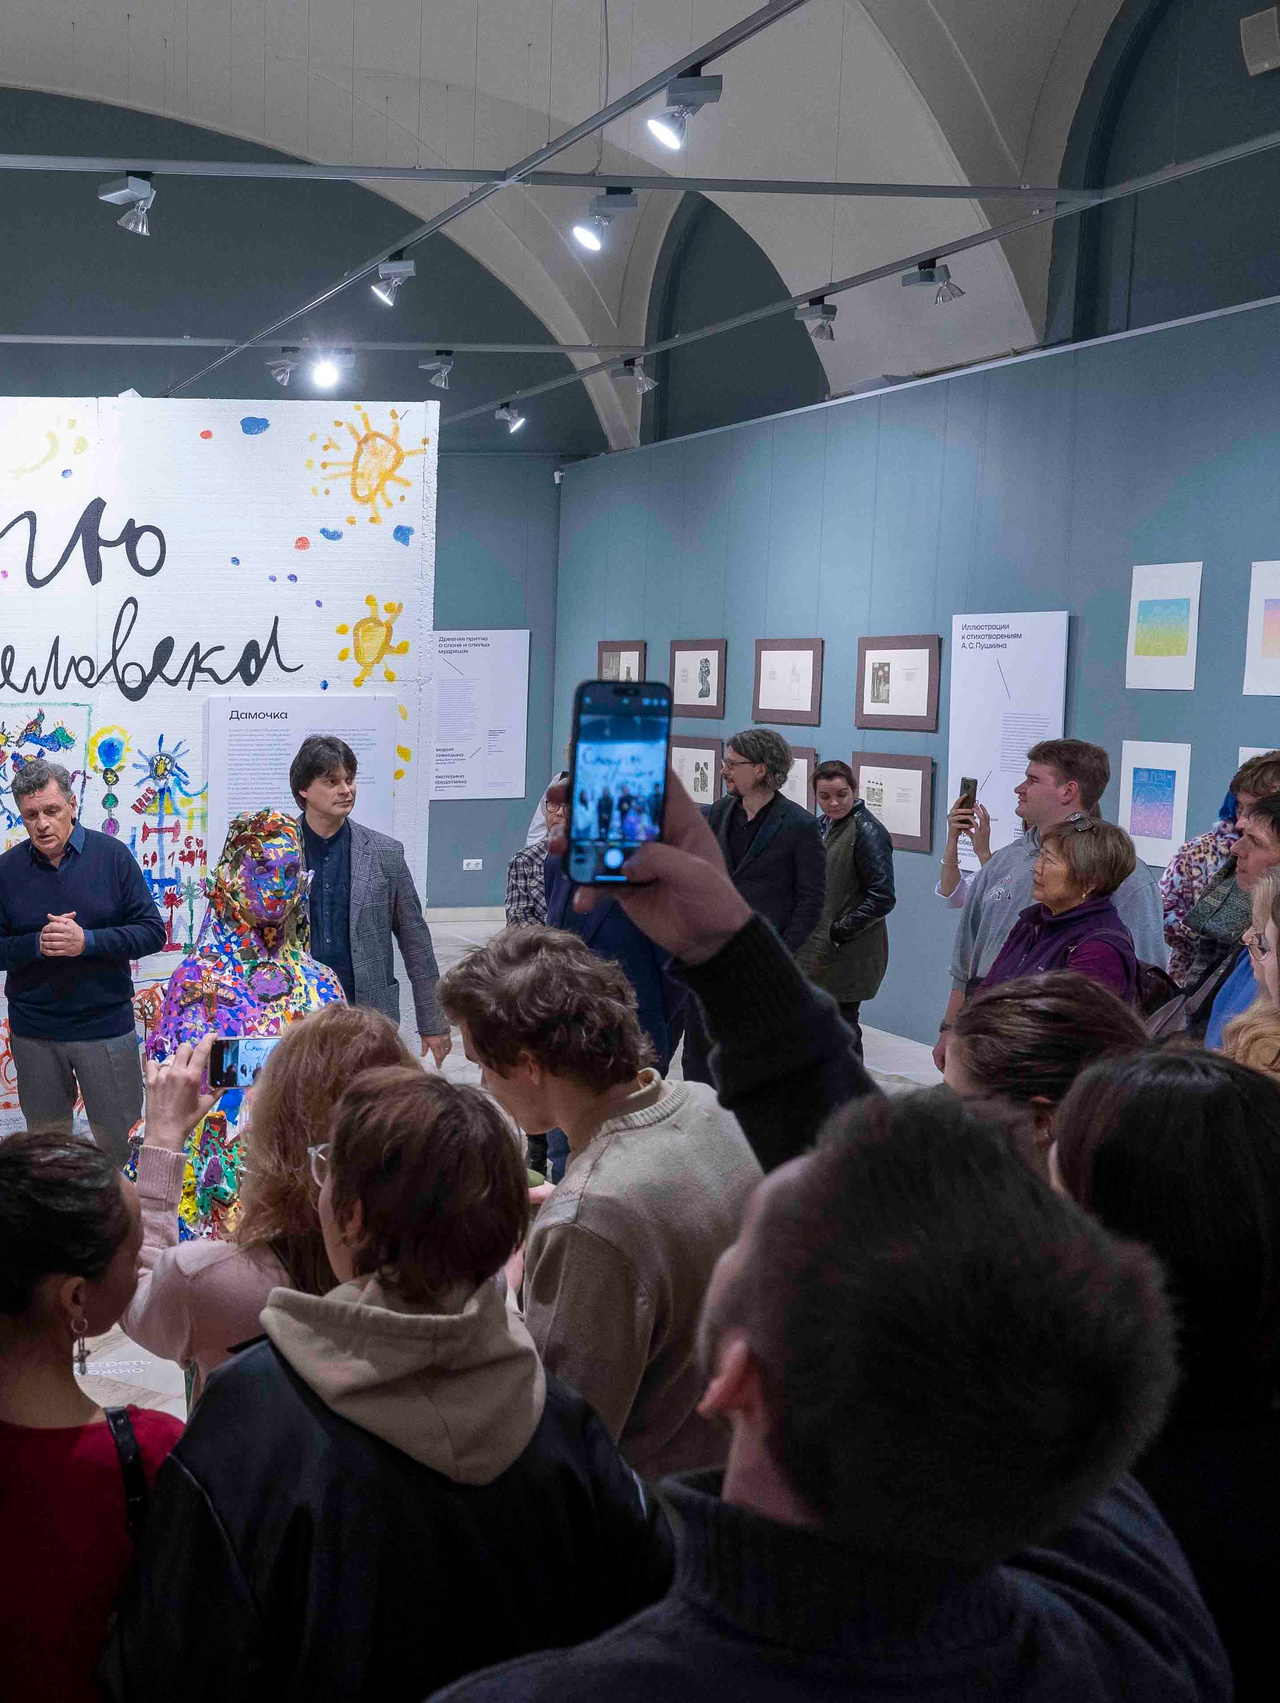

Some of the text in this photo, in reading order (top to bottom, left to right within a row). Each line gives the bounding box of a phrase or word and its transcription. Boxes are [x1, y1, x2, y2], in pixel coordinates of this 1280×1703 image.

[966, 633, 1023, 641] стихотворениям
[975, 642, 1007, 651] Пушкина
[228, 710, 289, 721] Дамочка
